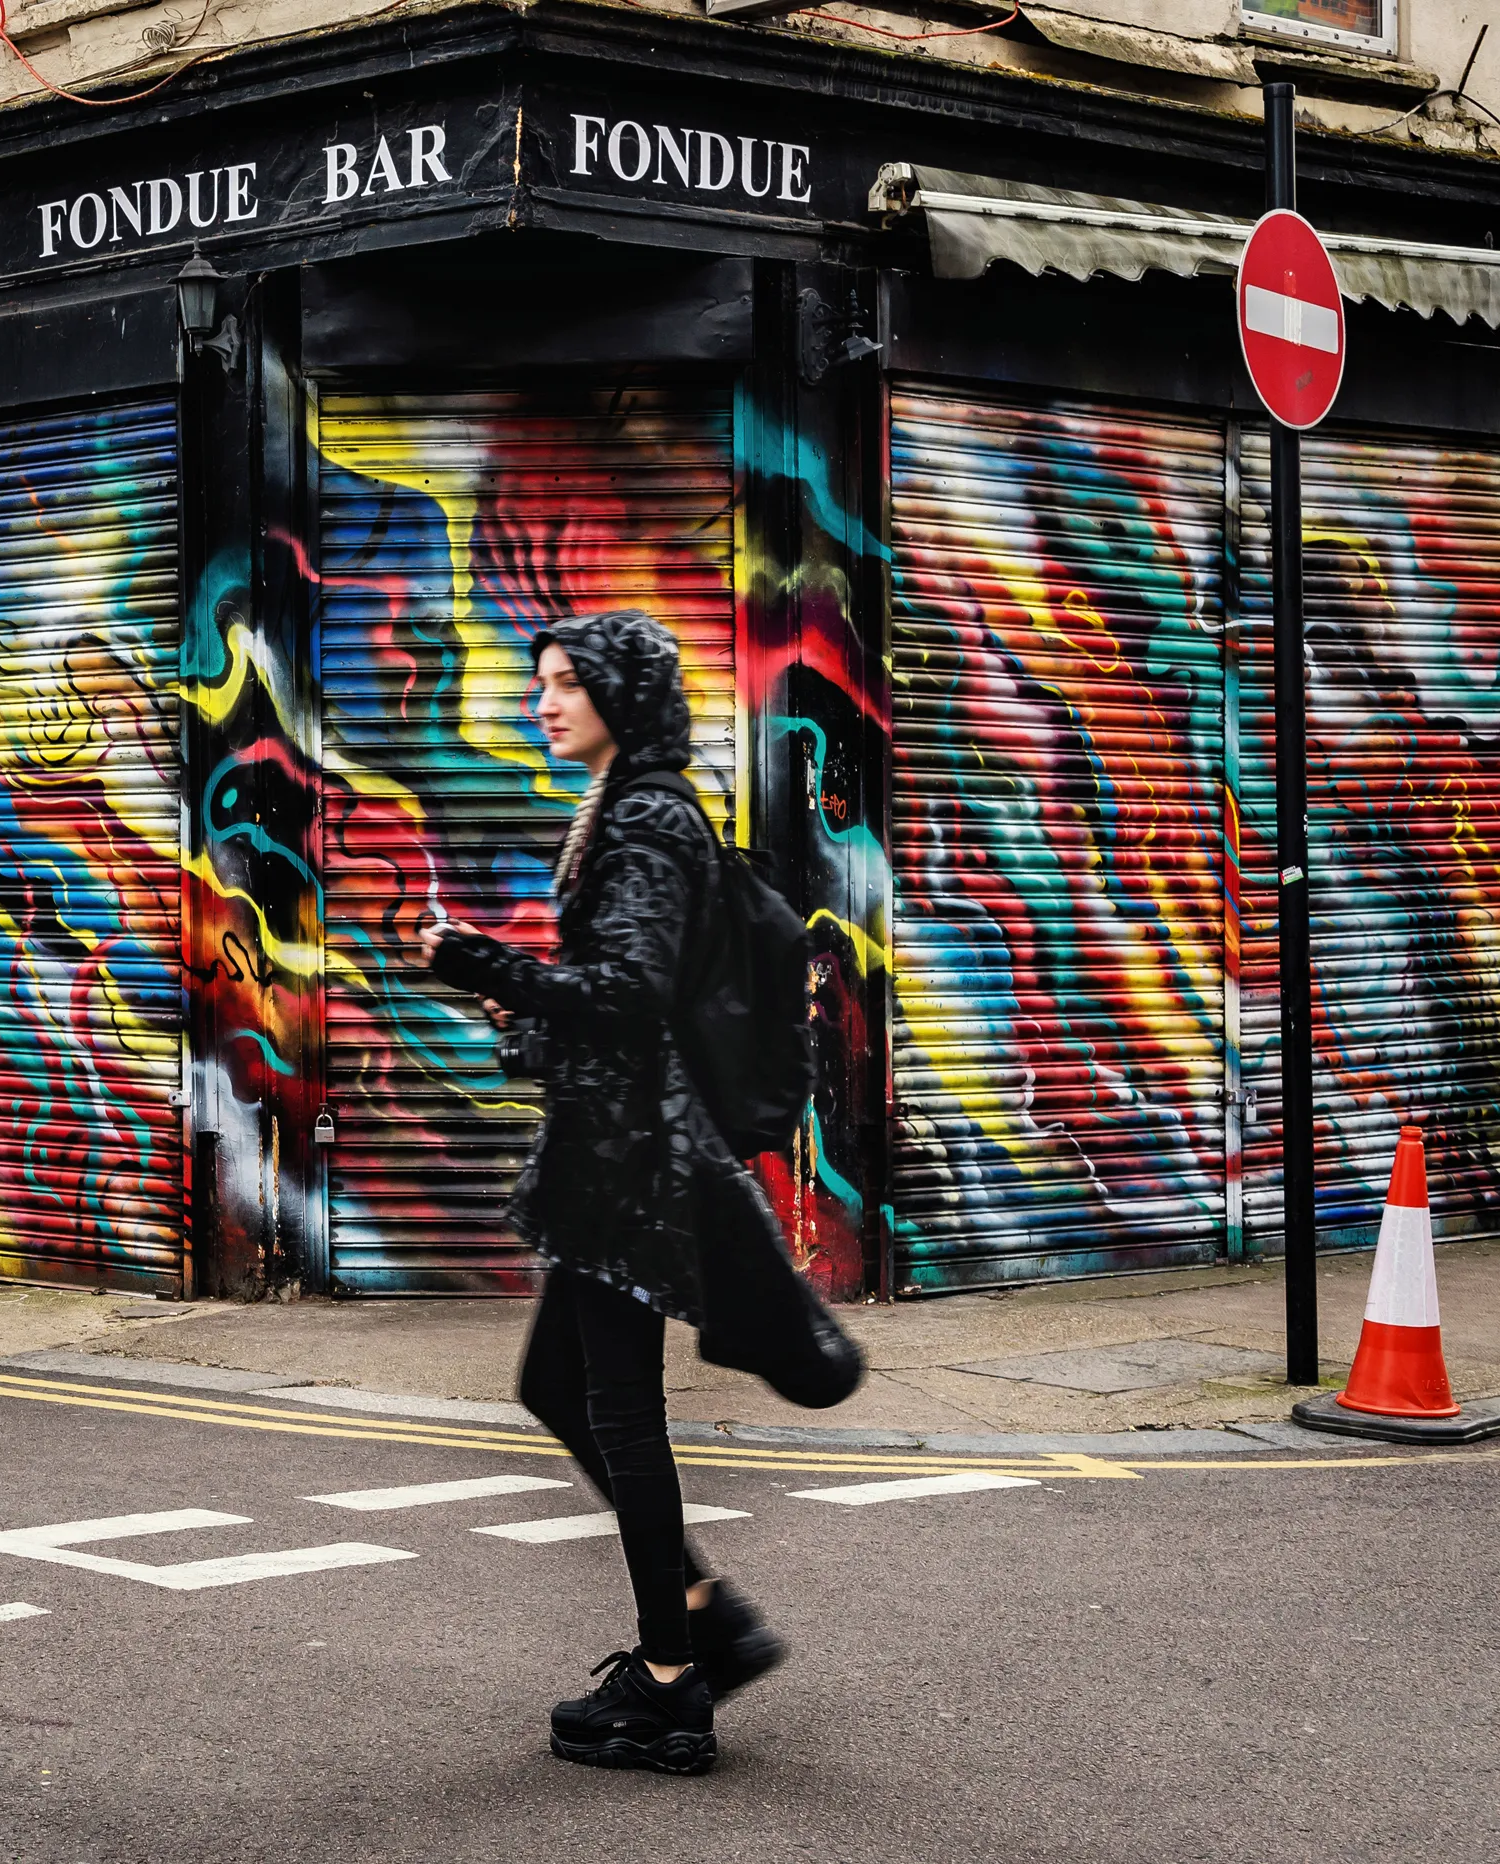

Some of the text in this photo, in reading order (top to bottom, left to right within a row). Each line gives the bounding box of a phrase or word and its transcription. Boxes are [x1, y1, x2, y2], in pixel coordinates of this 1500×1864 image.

[37, 162, 259, 258] FONDUE
[321, 124, 453, 205] BAR
[569, 113, 813, 204] FONDUE
